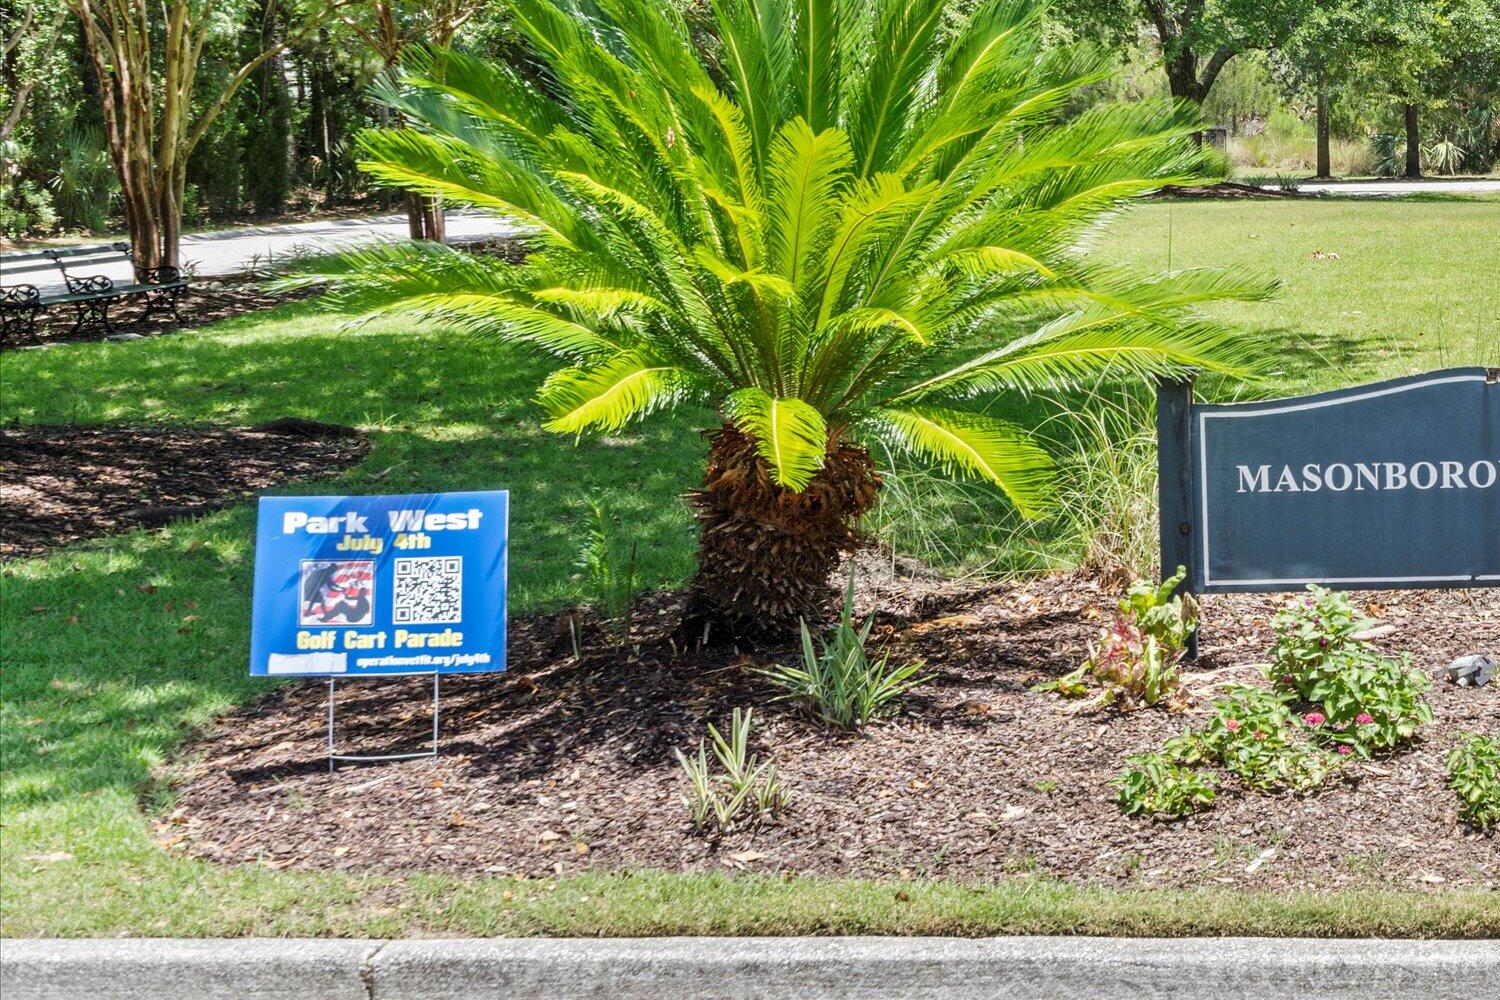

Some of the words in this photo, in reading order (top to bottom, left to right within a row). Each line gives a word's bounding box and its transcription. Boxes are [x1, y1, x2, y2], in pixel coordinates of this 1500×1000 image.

[282, 511, 369, 534] Park
[388, 508, 483, 532] West
[336, 534, 384, 554] July
[392, 532, 432, 550] 4th
[296, 630, 337, 650] Golf
[343, 631, 387, 650] Cart
[394, 628, 464, 648] Parade
